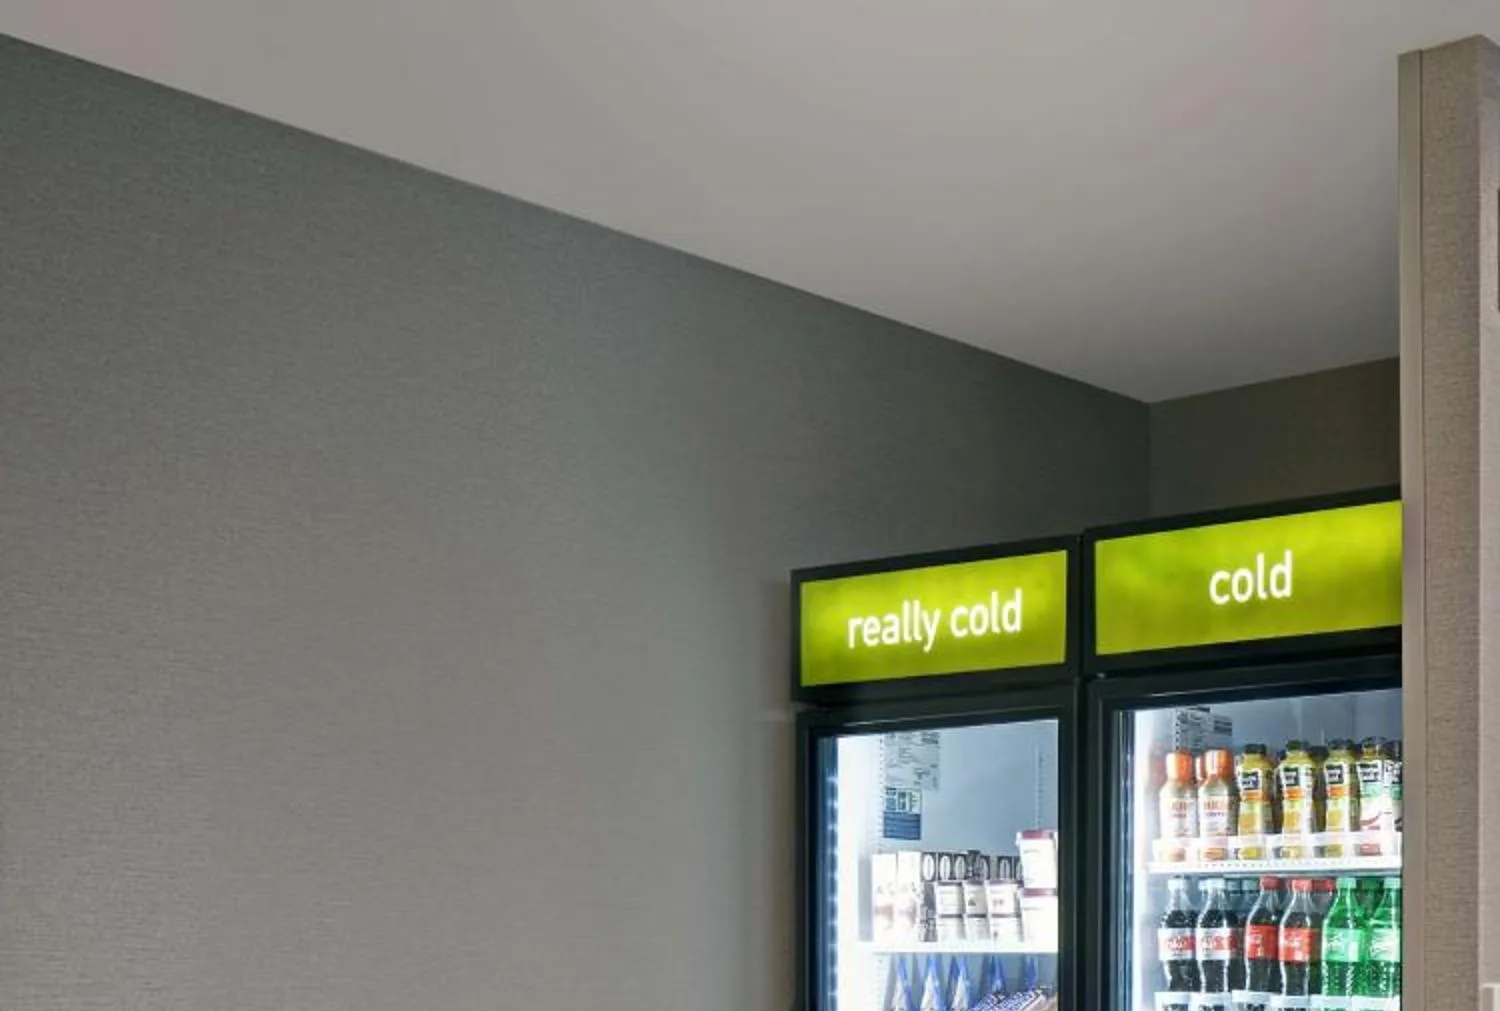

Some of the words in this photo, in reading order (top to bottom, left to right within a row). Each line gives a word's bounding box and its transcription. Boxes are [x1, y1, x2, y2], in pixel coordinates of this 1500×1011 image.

[1210, 550, 1294, 605] cold
[847, 599, 941, 653] really
[951, 589, 1023, 638] cold
